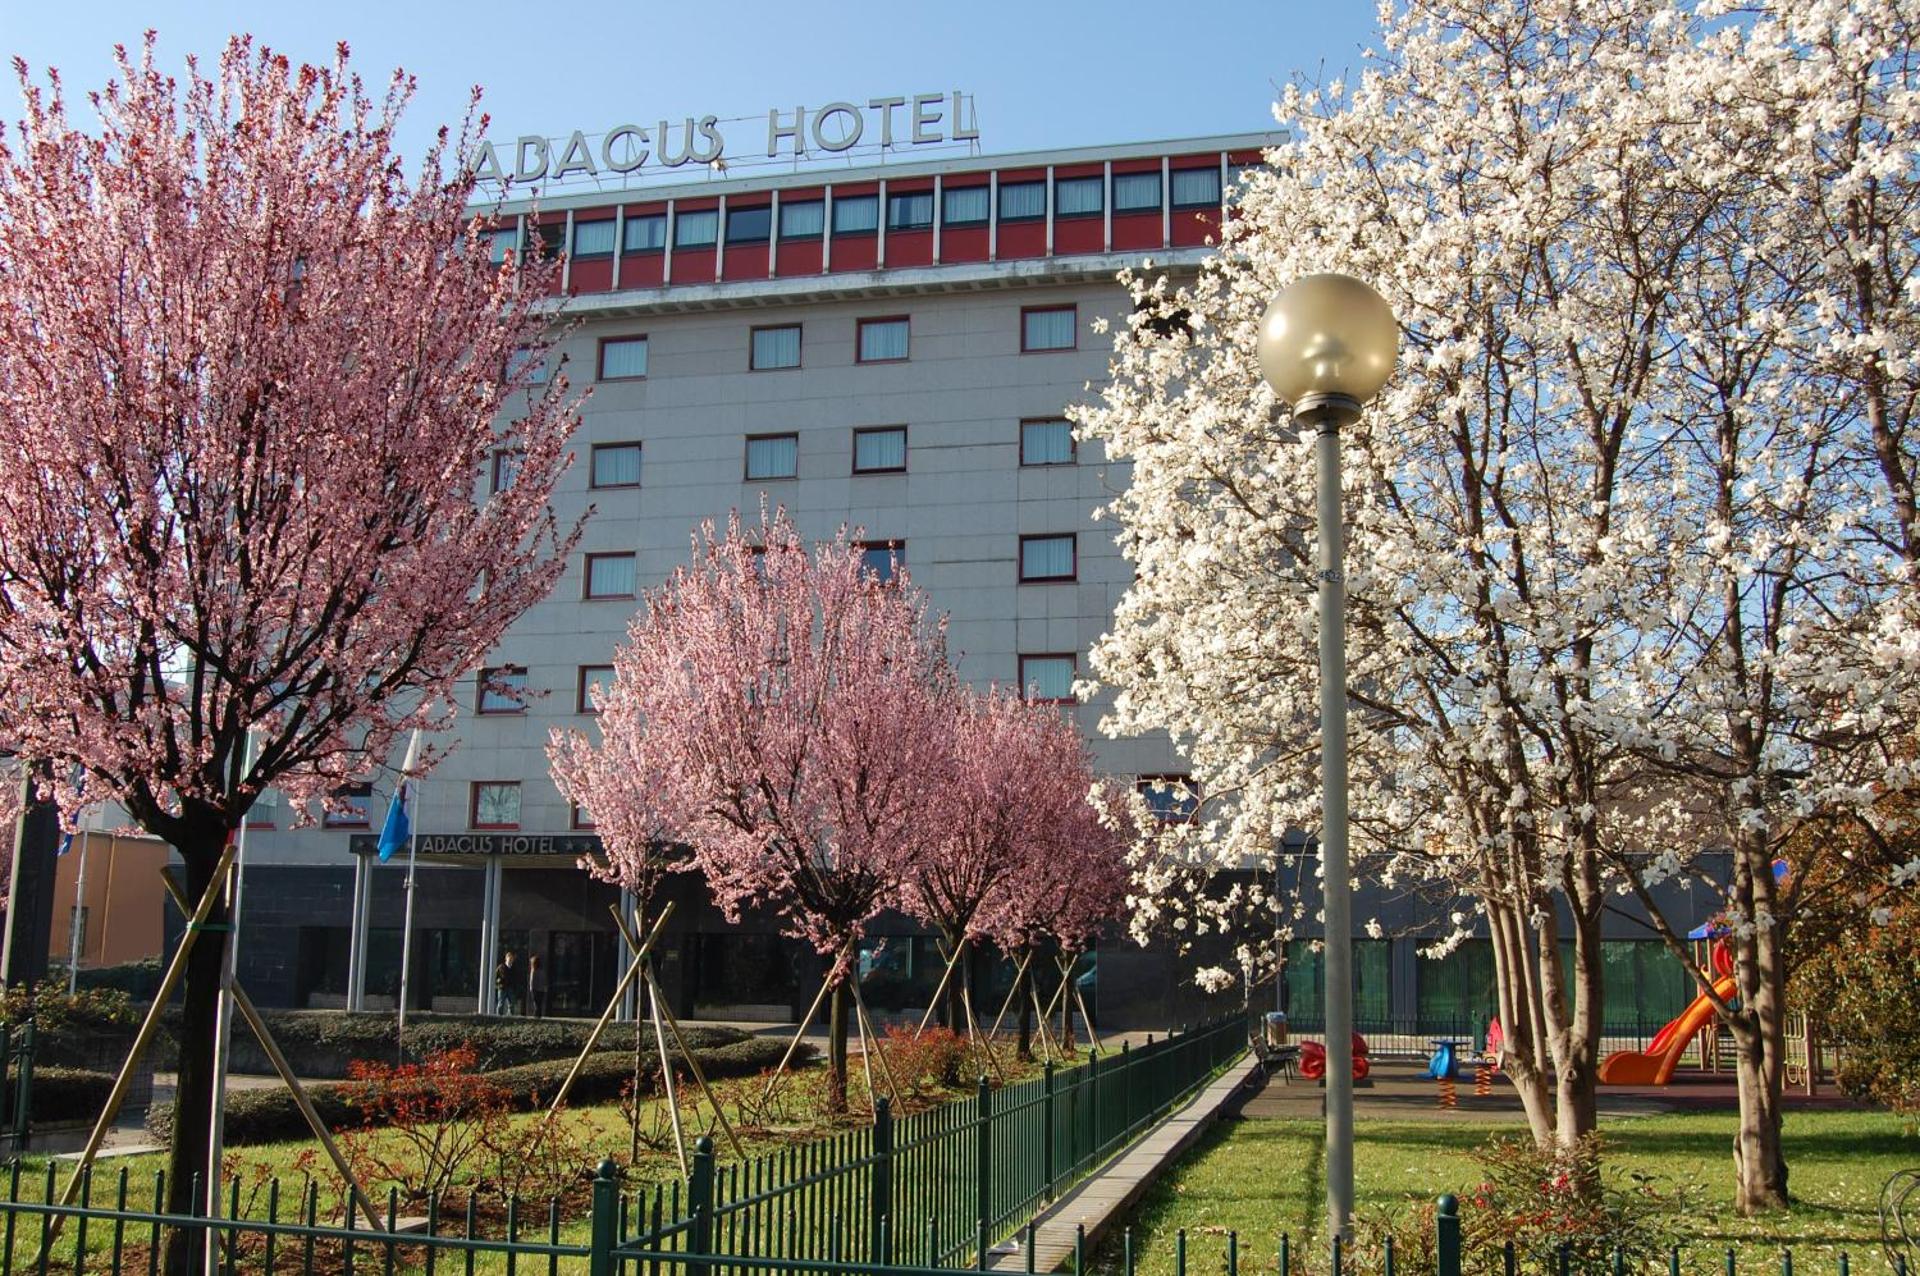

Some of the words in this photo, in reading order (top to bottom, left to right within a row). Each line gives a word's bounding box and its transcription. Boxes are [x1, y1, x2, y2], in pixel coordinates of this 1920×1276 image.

[473, 116, 724, 184] ABACUS
[768, 90, 979, 157] HOTEL
[421, 836, 494, 853] ABACUS
[501, 836, 557, 854] HOTEL
